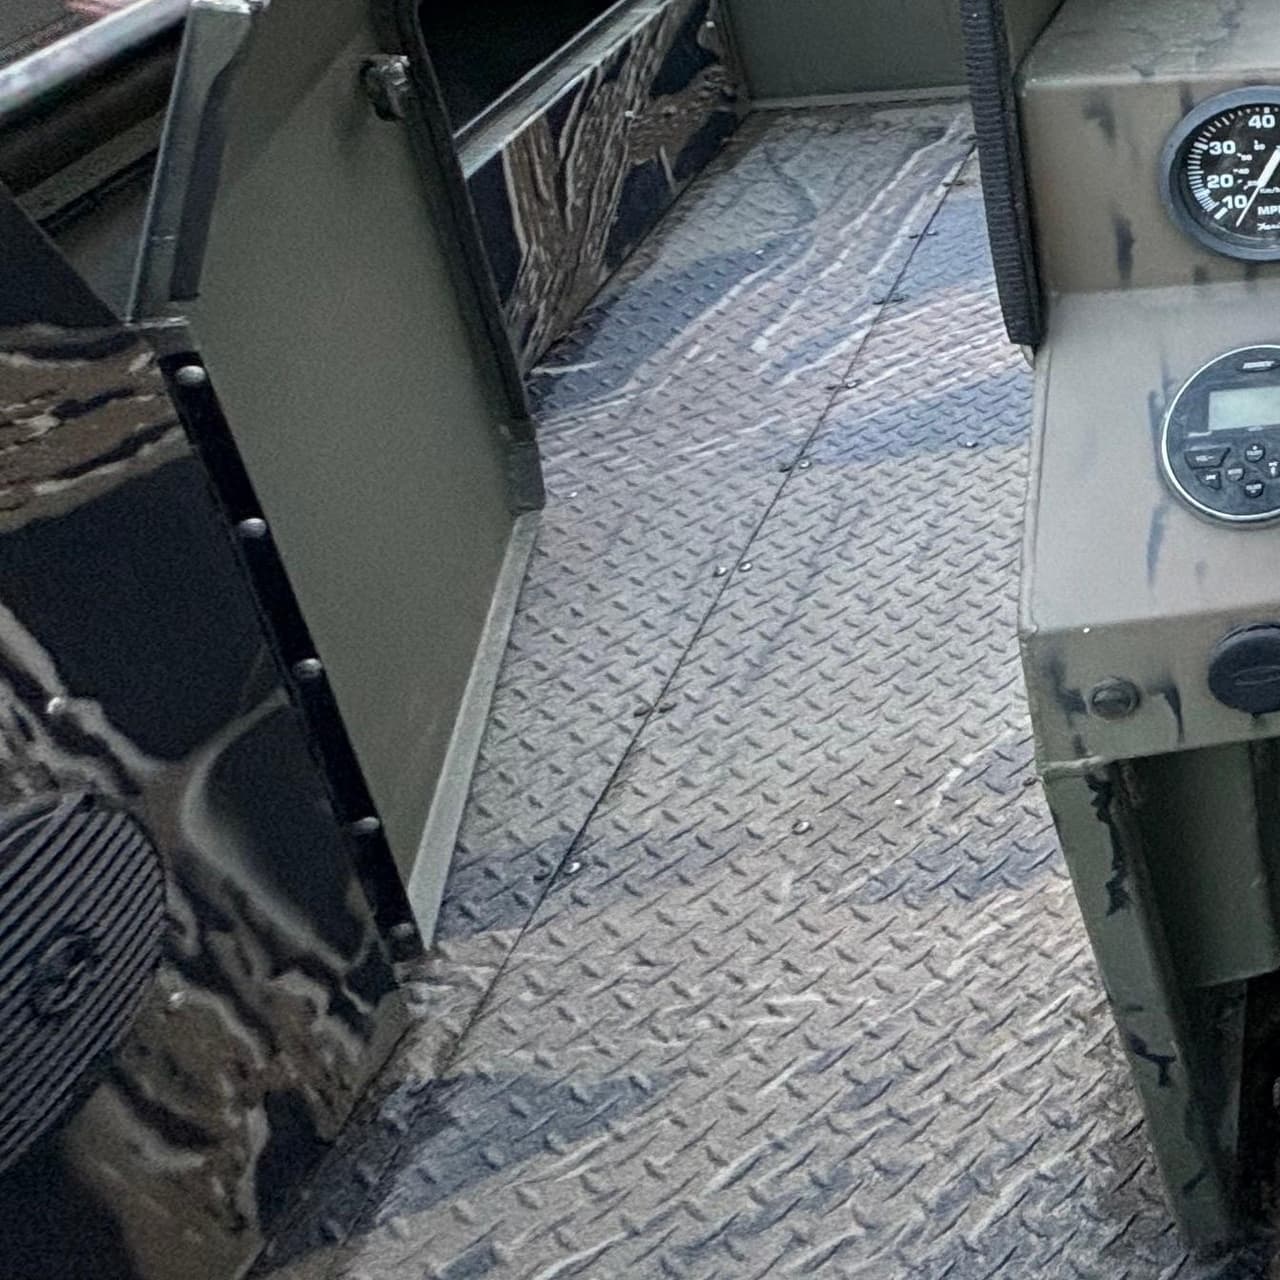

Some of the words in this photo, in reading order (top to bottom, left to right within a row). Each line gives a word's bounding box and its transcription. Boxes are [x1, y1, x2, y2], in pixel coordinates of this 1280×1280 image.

[1248, 114, 1275, 128] 40
[1209, 141, 1236, 155] 30
[1207, 174, 1234, 189] 20
[1222, 195, 1247, 209] 10
